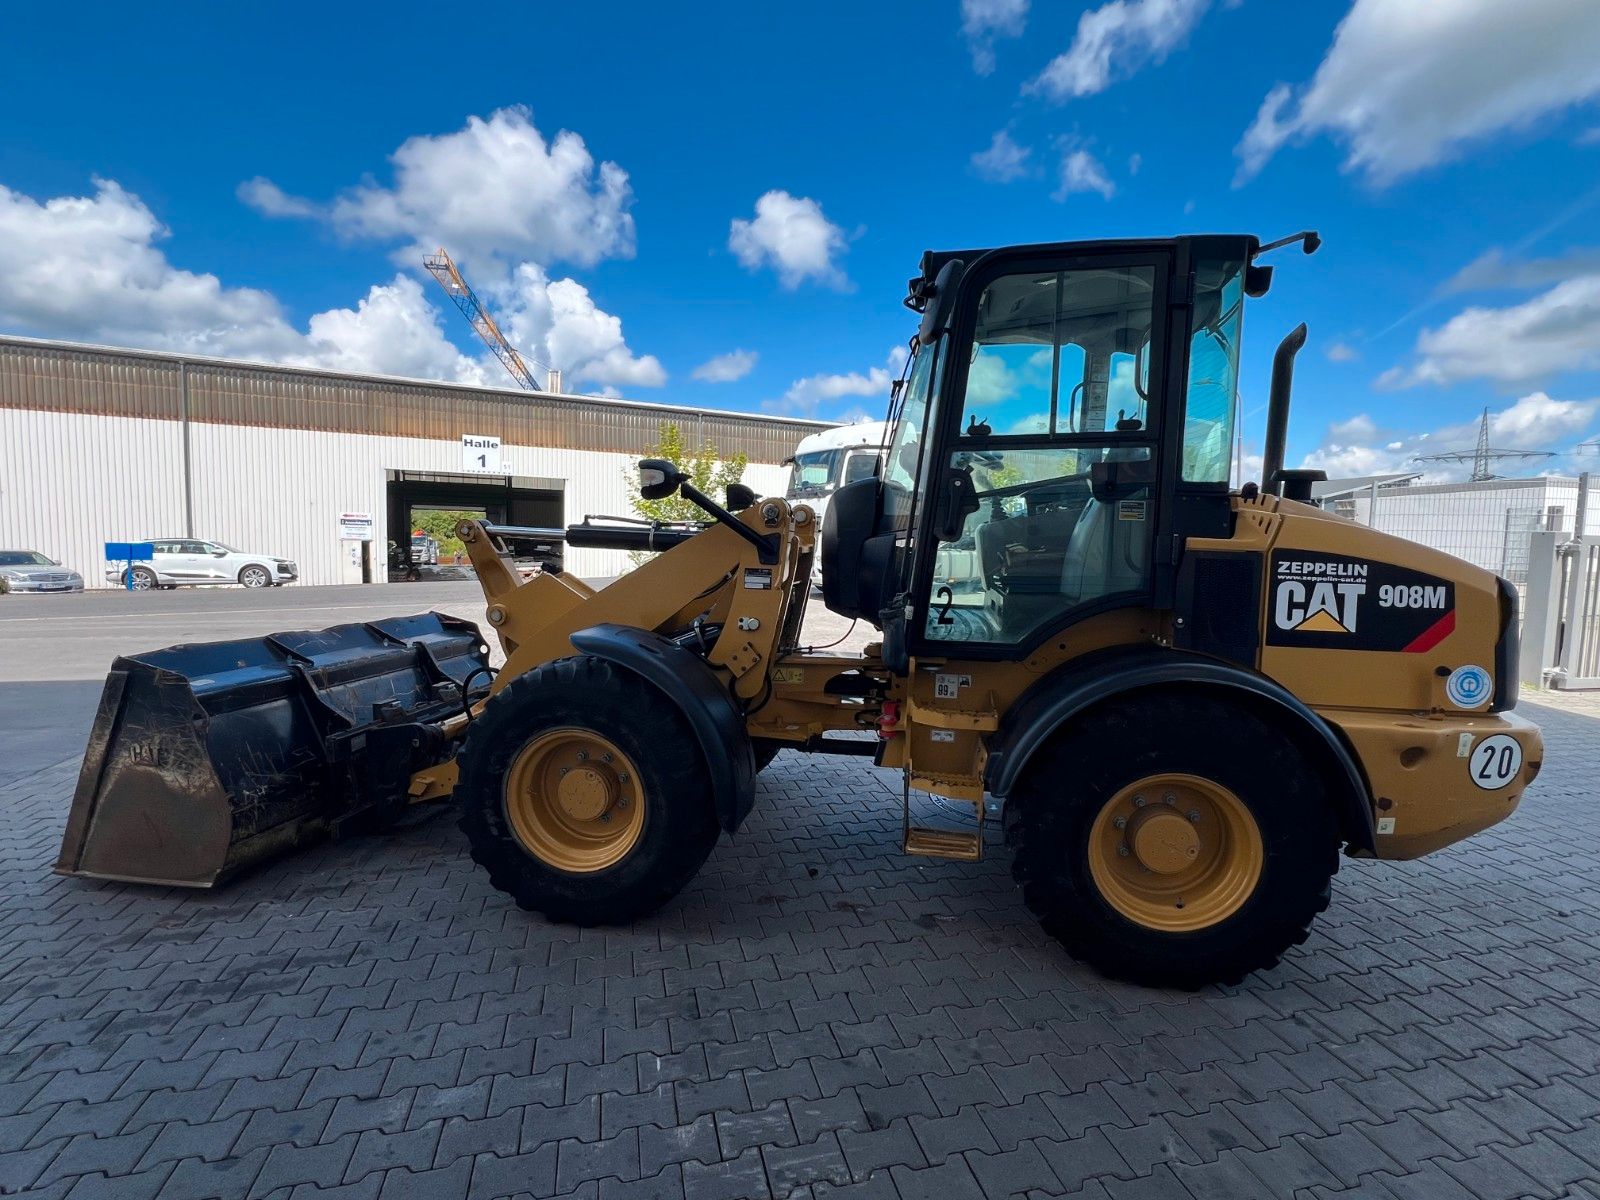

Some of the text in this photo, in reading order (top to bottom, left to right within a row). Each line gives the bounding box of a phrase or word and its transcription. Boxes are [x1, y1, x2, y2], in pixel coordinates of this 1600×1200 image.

[463, 438, 499, 449] Halle
[477, 454, 486, 468] 1
[1277, 561, 1368, 577] ZEPPELIN
[1277, 574, 1367, 583] www.zeppelin-cat.de
[1378, 584, 1446, 609] 908M
[937, 586, 954, 625] 2
[1275, 581, 1366, 633] CAT
[938, 684, 949, 696] 99
[1478, 745, 1514, 779] 20
